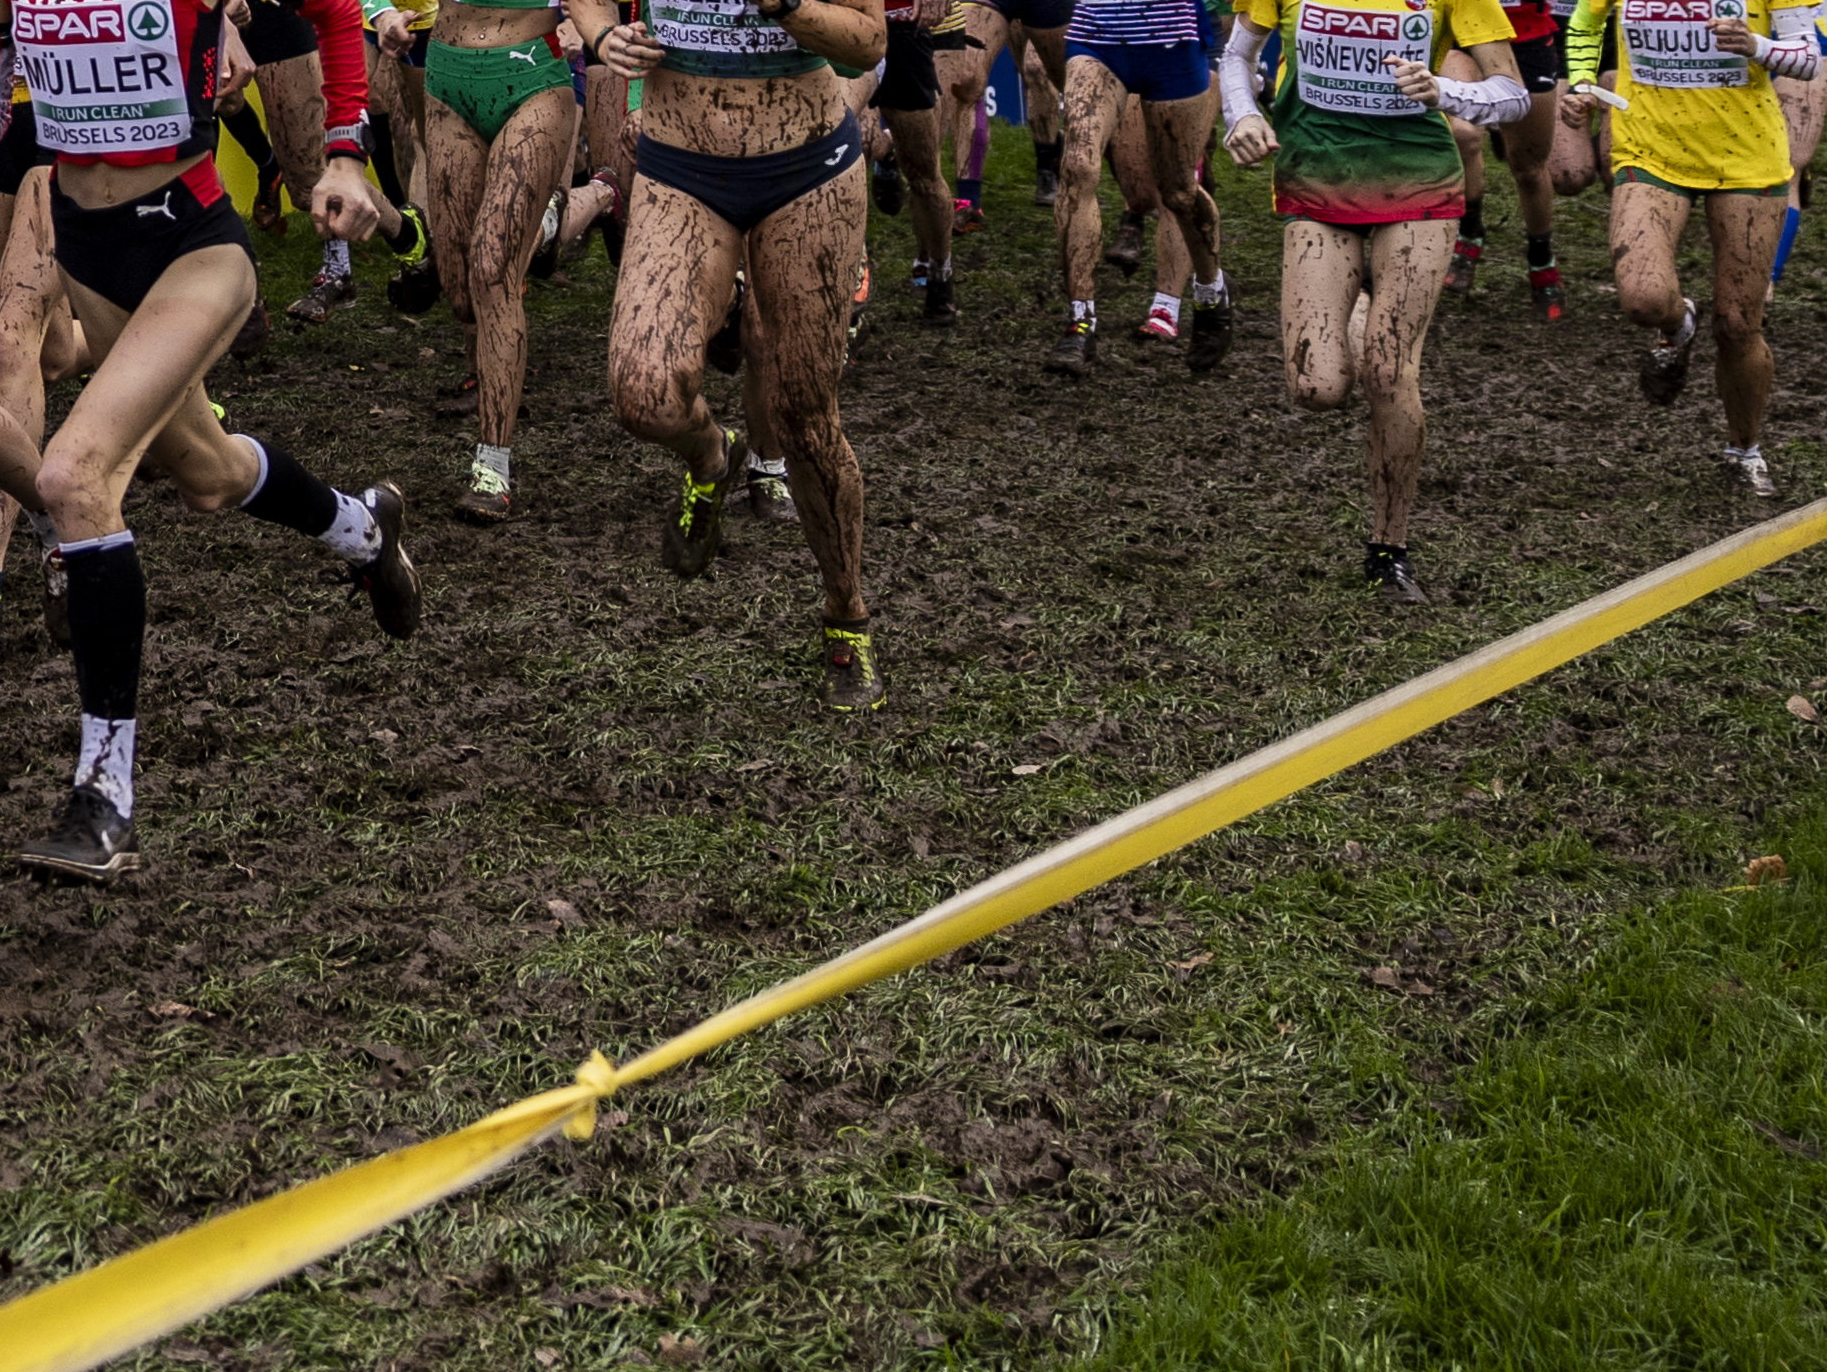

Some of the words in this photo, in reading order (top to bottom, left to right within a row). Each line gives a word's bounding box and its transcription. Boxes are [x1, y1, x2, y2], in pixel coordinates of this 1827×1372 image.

[1627, 0, 1711, 19] SPAR
[16, 9, 123, 40] SPAR
[1303, 8, 1398, 37] SPAR
[21, 51, 174, 96] MÜLLER
[1327, 79, 1356, 90] RUN
[1638, 68, 1705, 83] BRUSSELS
[1305, 86, 1382, 110] BRUSSELS
[57, 107, 89, 121] RUN
[43, 123, 126, 145] BRUSSELS
[129, 121, 181, 143] 2023
